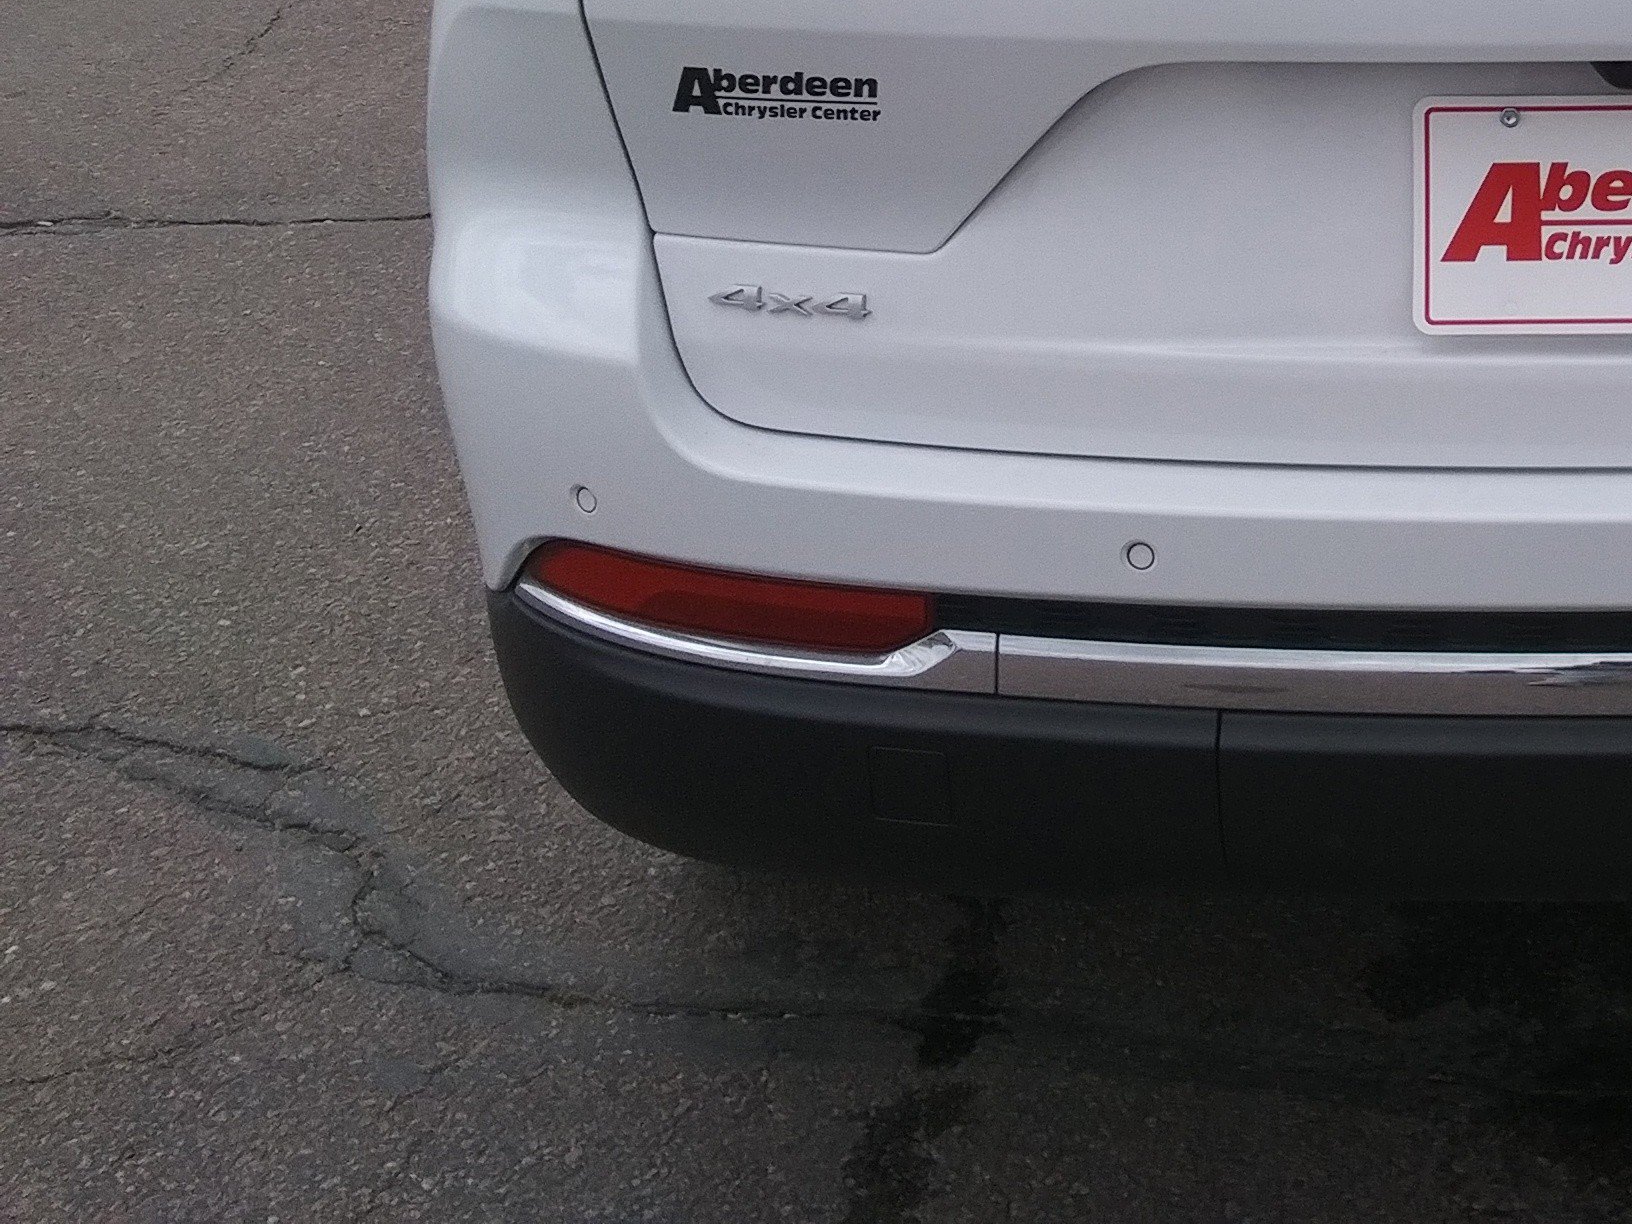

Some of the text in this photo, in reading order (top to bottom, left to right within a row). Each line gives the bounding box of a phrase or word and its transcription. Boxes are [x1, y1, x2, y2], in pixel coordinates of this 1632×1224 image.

[672, 66, 879, 116] Aberdeen
[722, 102, 881, 122] Chrysler Center
